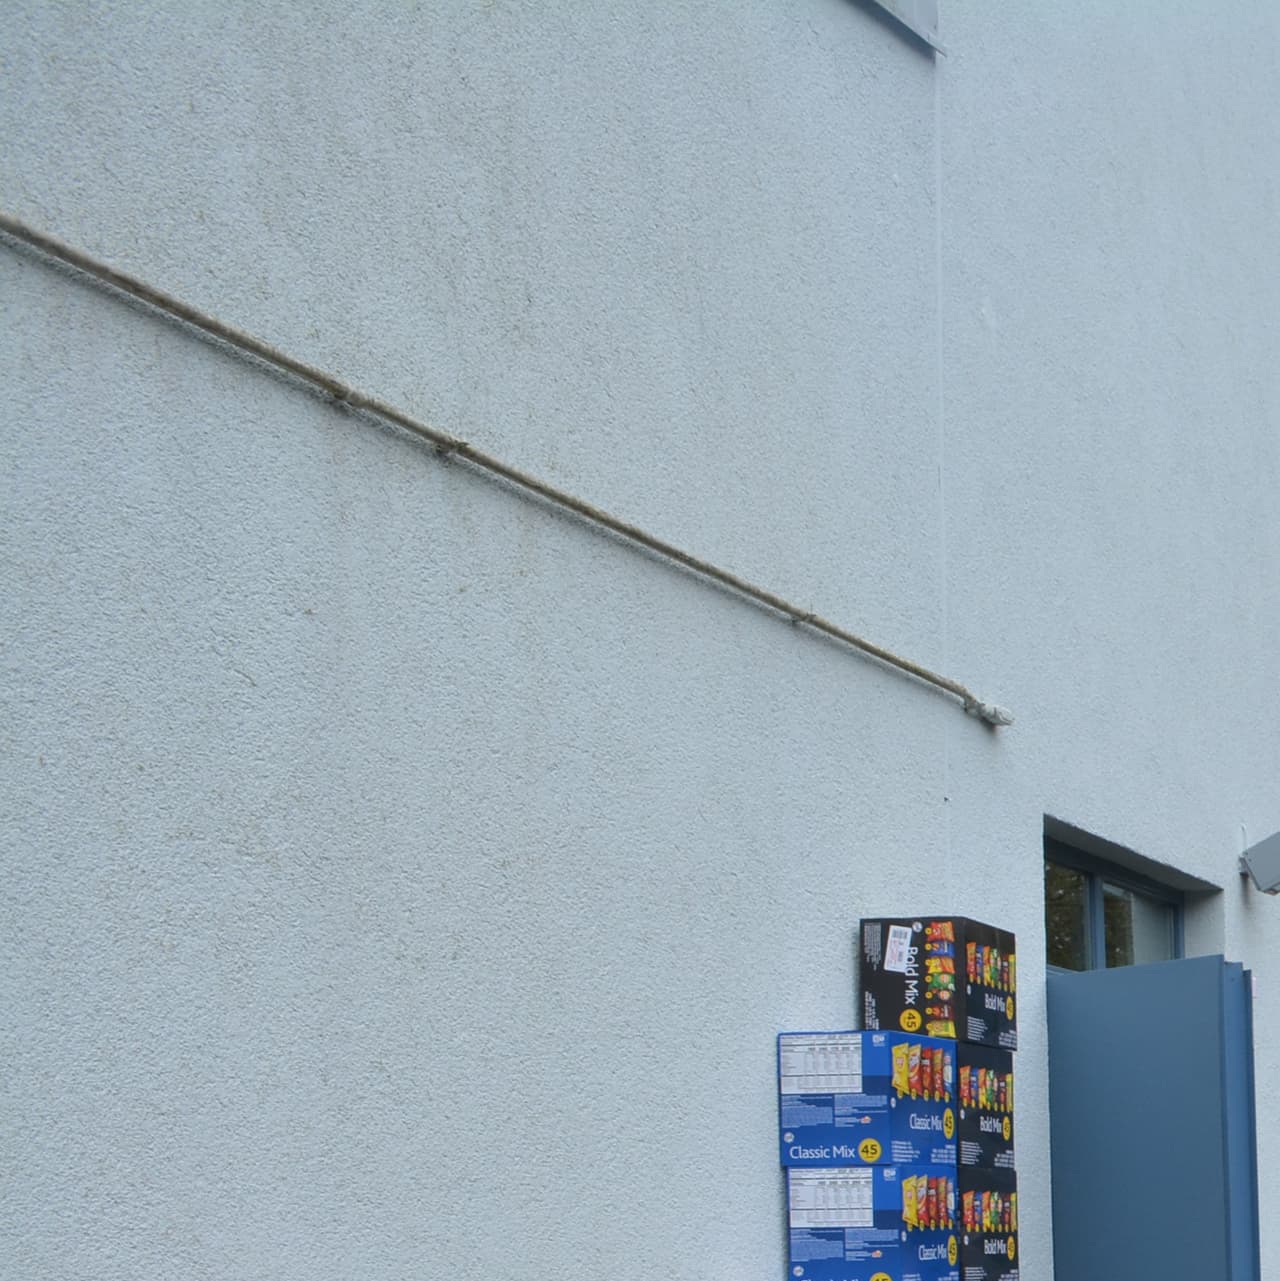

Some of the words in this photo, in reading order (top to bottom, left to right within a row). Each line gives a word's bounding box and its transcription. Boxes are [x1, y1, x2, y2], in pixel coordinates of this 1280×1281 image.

[905, 946, 919, 977] Bold
[904, 981, 920, 1005] Mix
[985, 993, 996, 1010] Bold
[906, 1012, 917, 1029] 45
[909, 1114, 929, 1130] Classic
[930, 1115, 943, 1130] Mix
[945, 1116, 953, 1130] 45
[980, 1117, 992, 1132] Bold
[992, 1119, 1002, 1133] Mix
[789, 1145, 831, 1160] Classic
[833, 1145, 855, 1158] Mix
[861, 1144, 878, 1155] 45
[918, 1245, 936, 1261] Classic
[936, 1245, 947, 1260] Mix
[984, 1241, 997, 1254] Bold
[997, 1242, 1006, 1254] Mix
